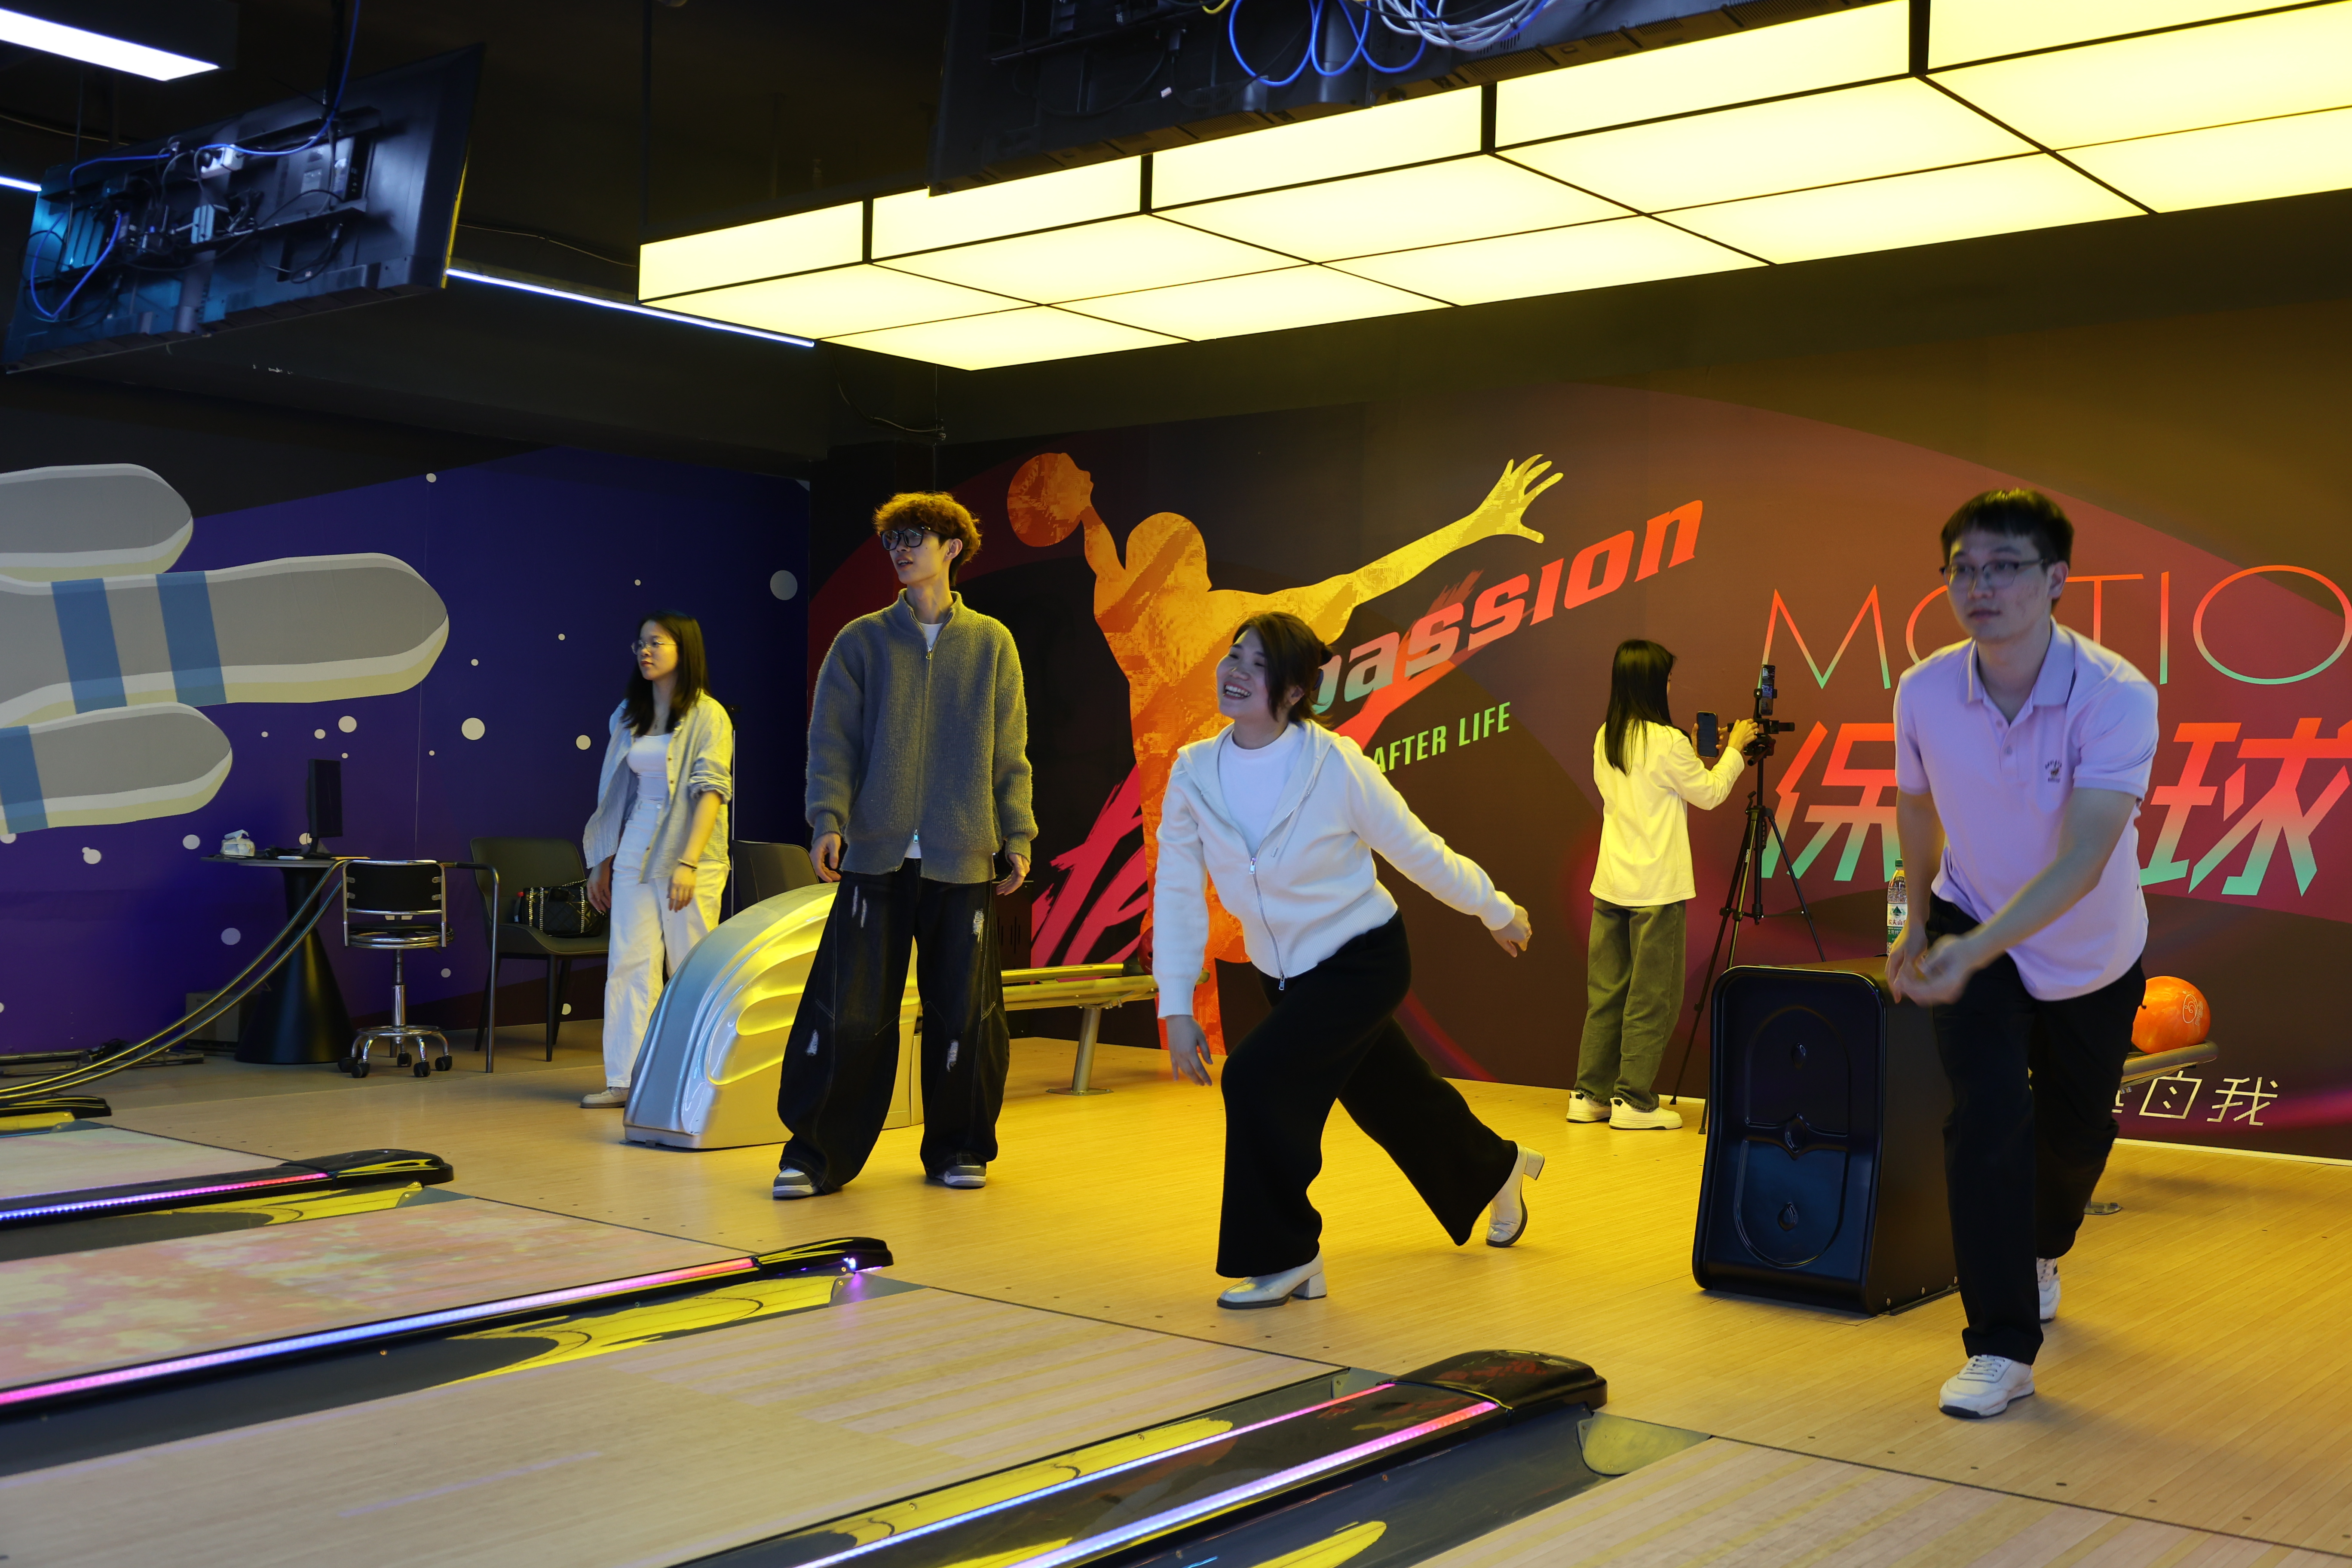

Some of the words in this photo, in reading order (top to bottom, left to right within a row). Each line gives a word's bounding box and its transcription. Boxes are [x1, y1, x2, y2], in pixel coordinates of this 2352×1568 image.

[1373, 725, 1446, 773] AFTER
[1459, 701, 1510, 747] LIFE
[1761, 717, 2352, 897] 保球
[2111, 1070, 2278, 1126] 自我
